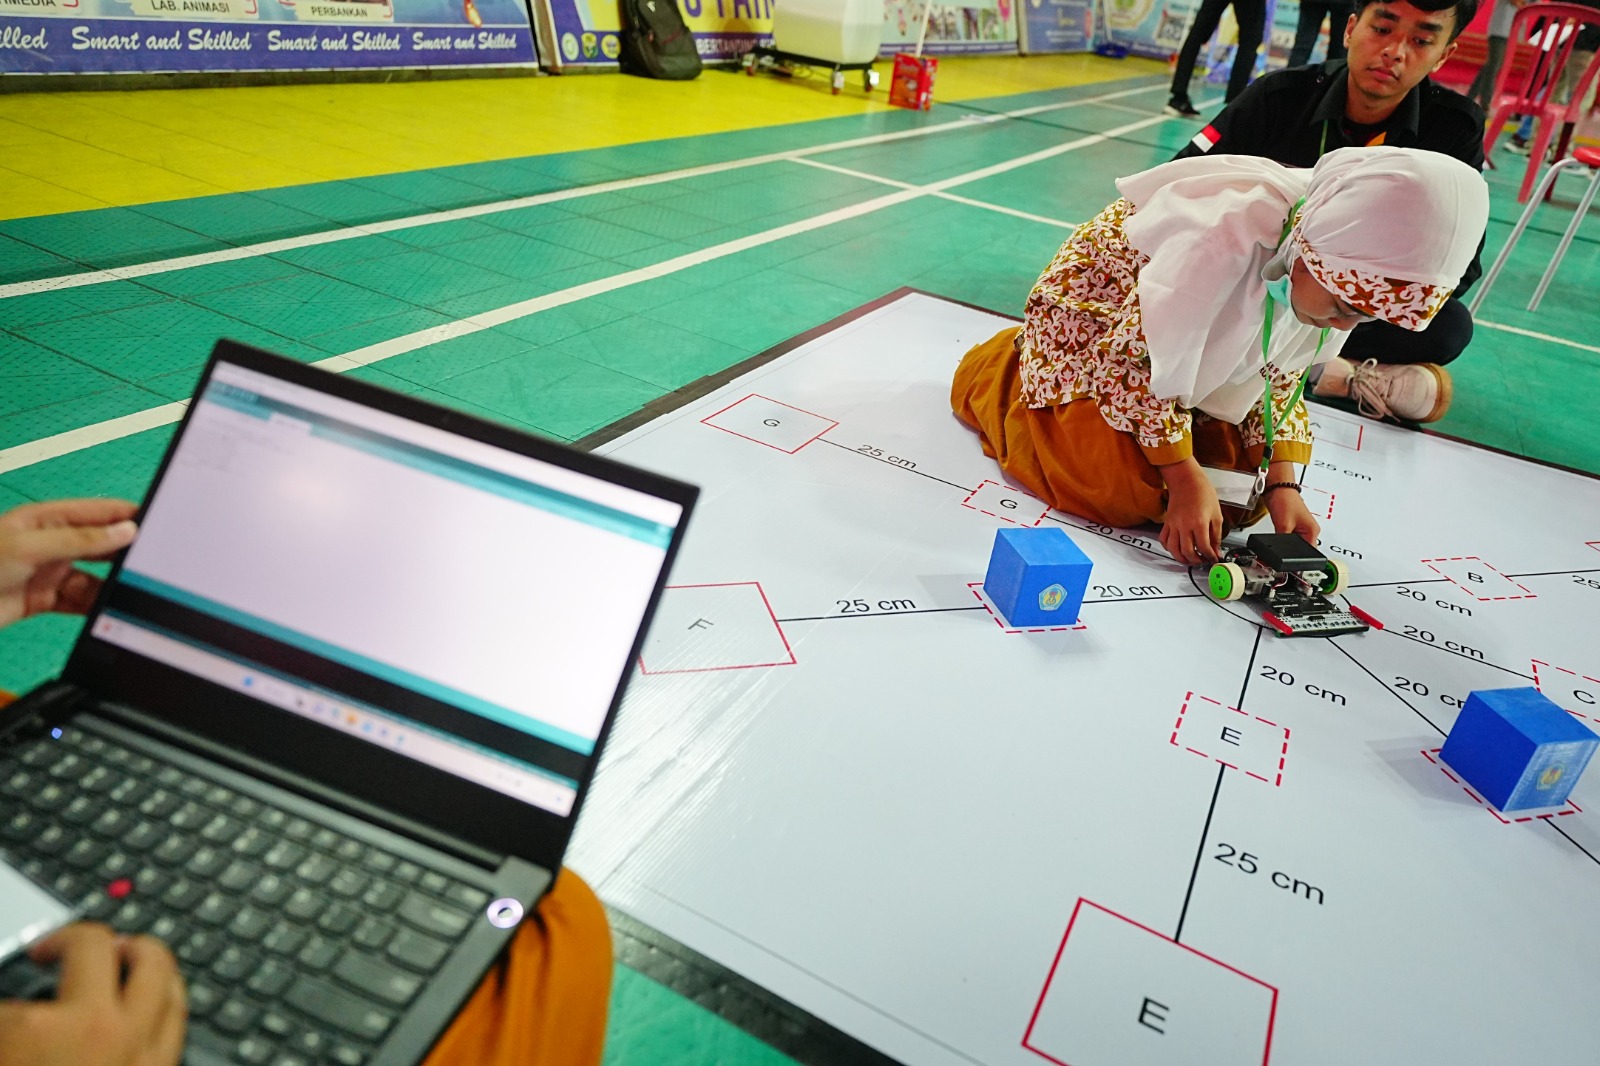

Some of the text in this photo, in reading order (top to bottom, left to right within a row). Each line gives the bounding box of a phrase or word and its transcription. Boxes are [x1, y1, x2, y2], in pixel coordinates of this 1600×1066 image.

[183, 1, 230, 13] ANIMASI
[310, 5, 368, 17] PERBANKAN
[71, 26, 252, 50] Smart and Skilled
[267, 30, 401, 51] Smart and Skilled
[412, 31, 517, 50] Smart and Skilled
[763, 418, 781, 428] G
[856, 444, 917, 469] 25 cm
[1314, 459, 1372, 482] 25 cm
[999, 499, 1018, 510] G
[1085, 520, 1152, 549] 20 cm
[1329, 545, 1363, 560] cm
[1467, 571, 1484, 584] B
[1572, 574, 1600, 590] 25
[1093, 584, 1164, 598] 20 cm
[1396, 585, 1473, 617] 20 cm
[837, 598, 917, 614] 25 cm
[687, 618, 715, 630] F
[1402, 625, 1485, 660] 20 cm
[1259, 665, 1347, 706] 20 cm
[1393, 676, 1430, 697] 20
[1573, 690, 1597, 705] C
[1220, 726, 1243, 747] E
[1213, 843, 1325, 906] 25 cm
[1138, 996, 1170, 1036] E
